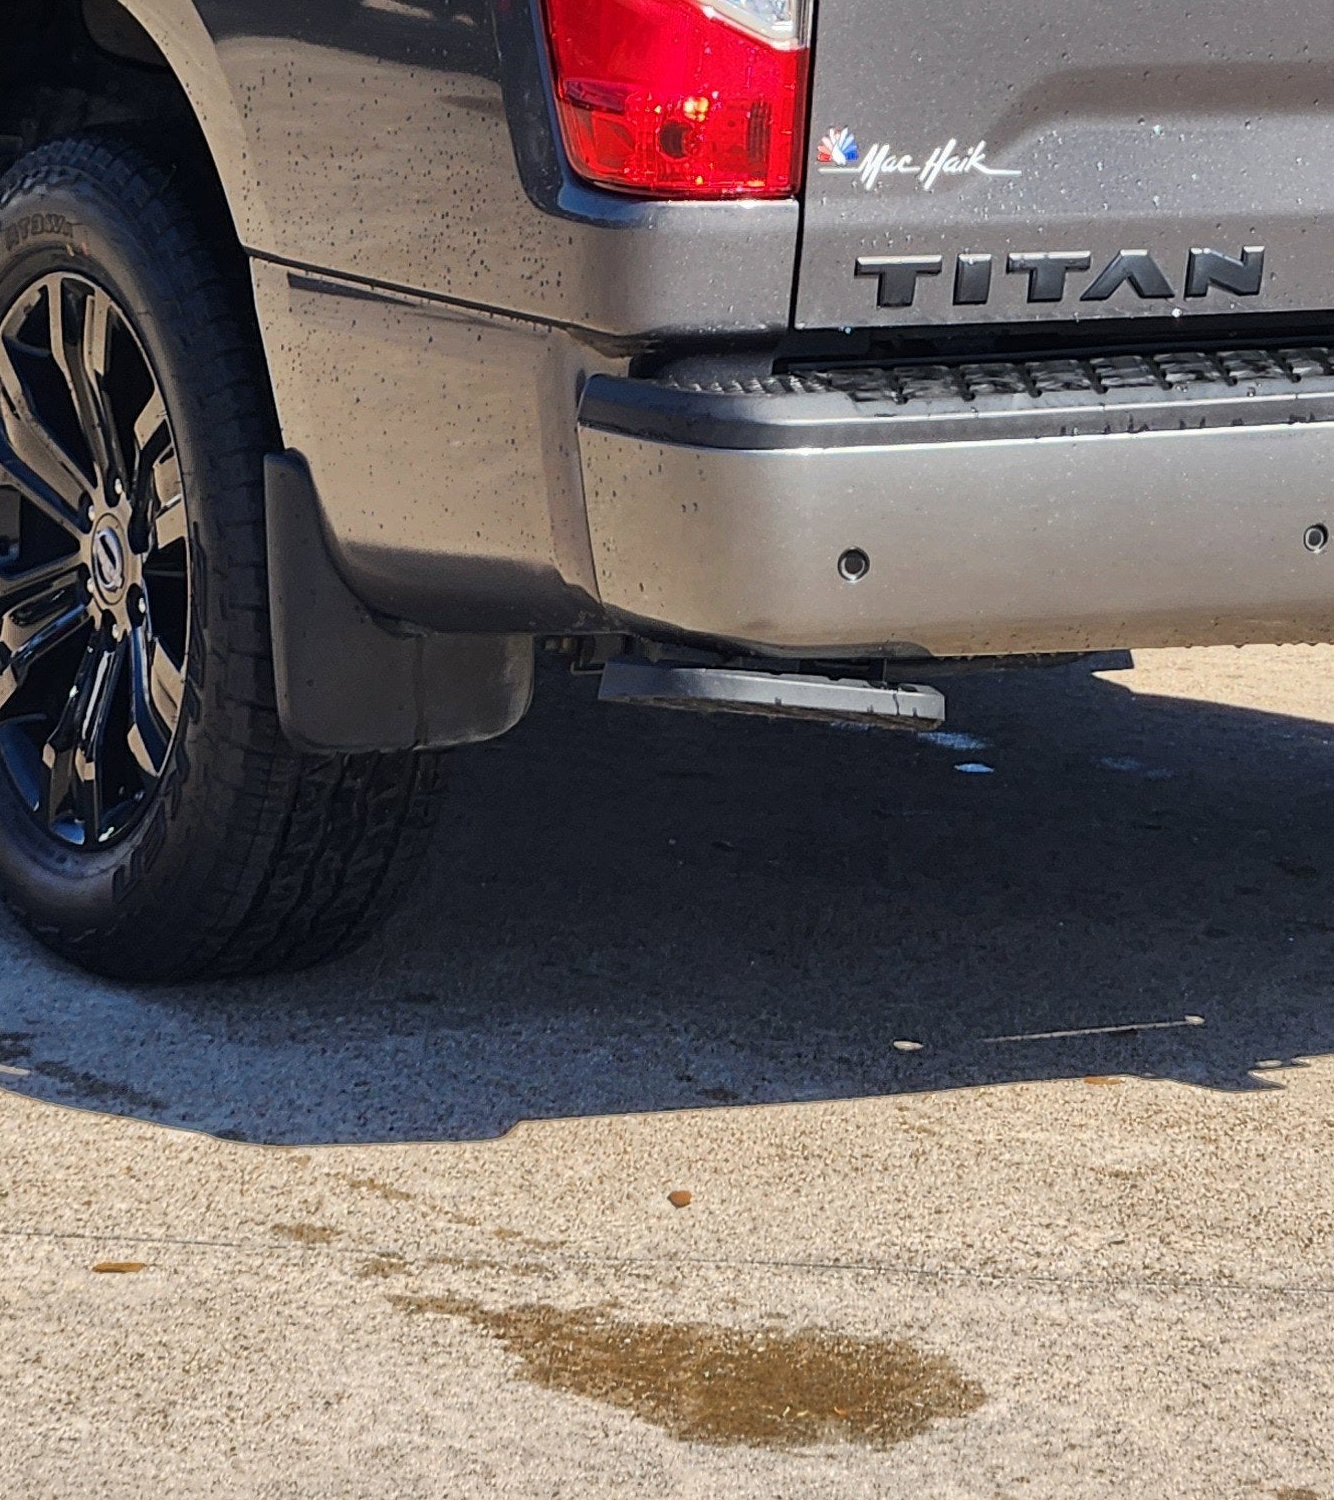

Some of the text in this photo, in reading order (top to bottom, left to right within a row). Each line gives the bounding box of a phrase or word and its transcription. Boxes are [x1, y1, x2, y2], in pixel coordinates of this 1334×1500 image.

[819, 137, 1022, 191] Mac Haik
[853, 245, 1266, 308] TITAN
